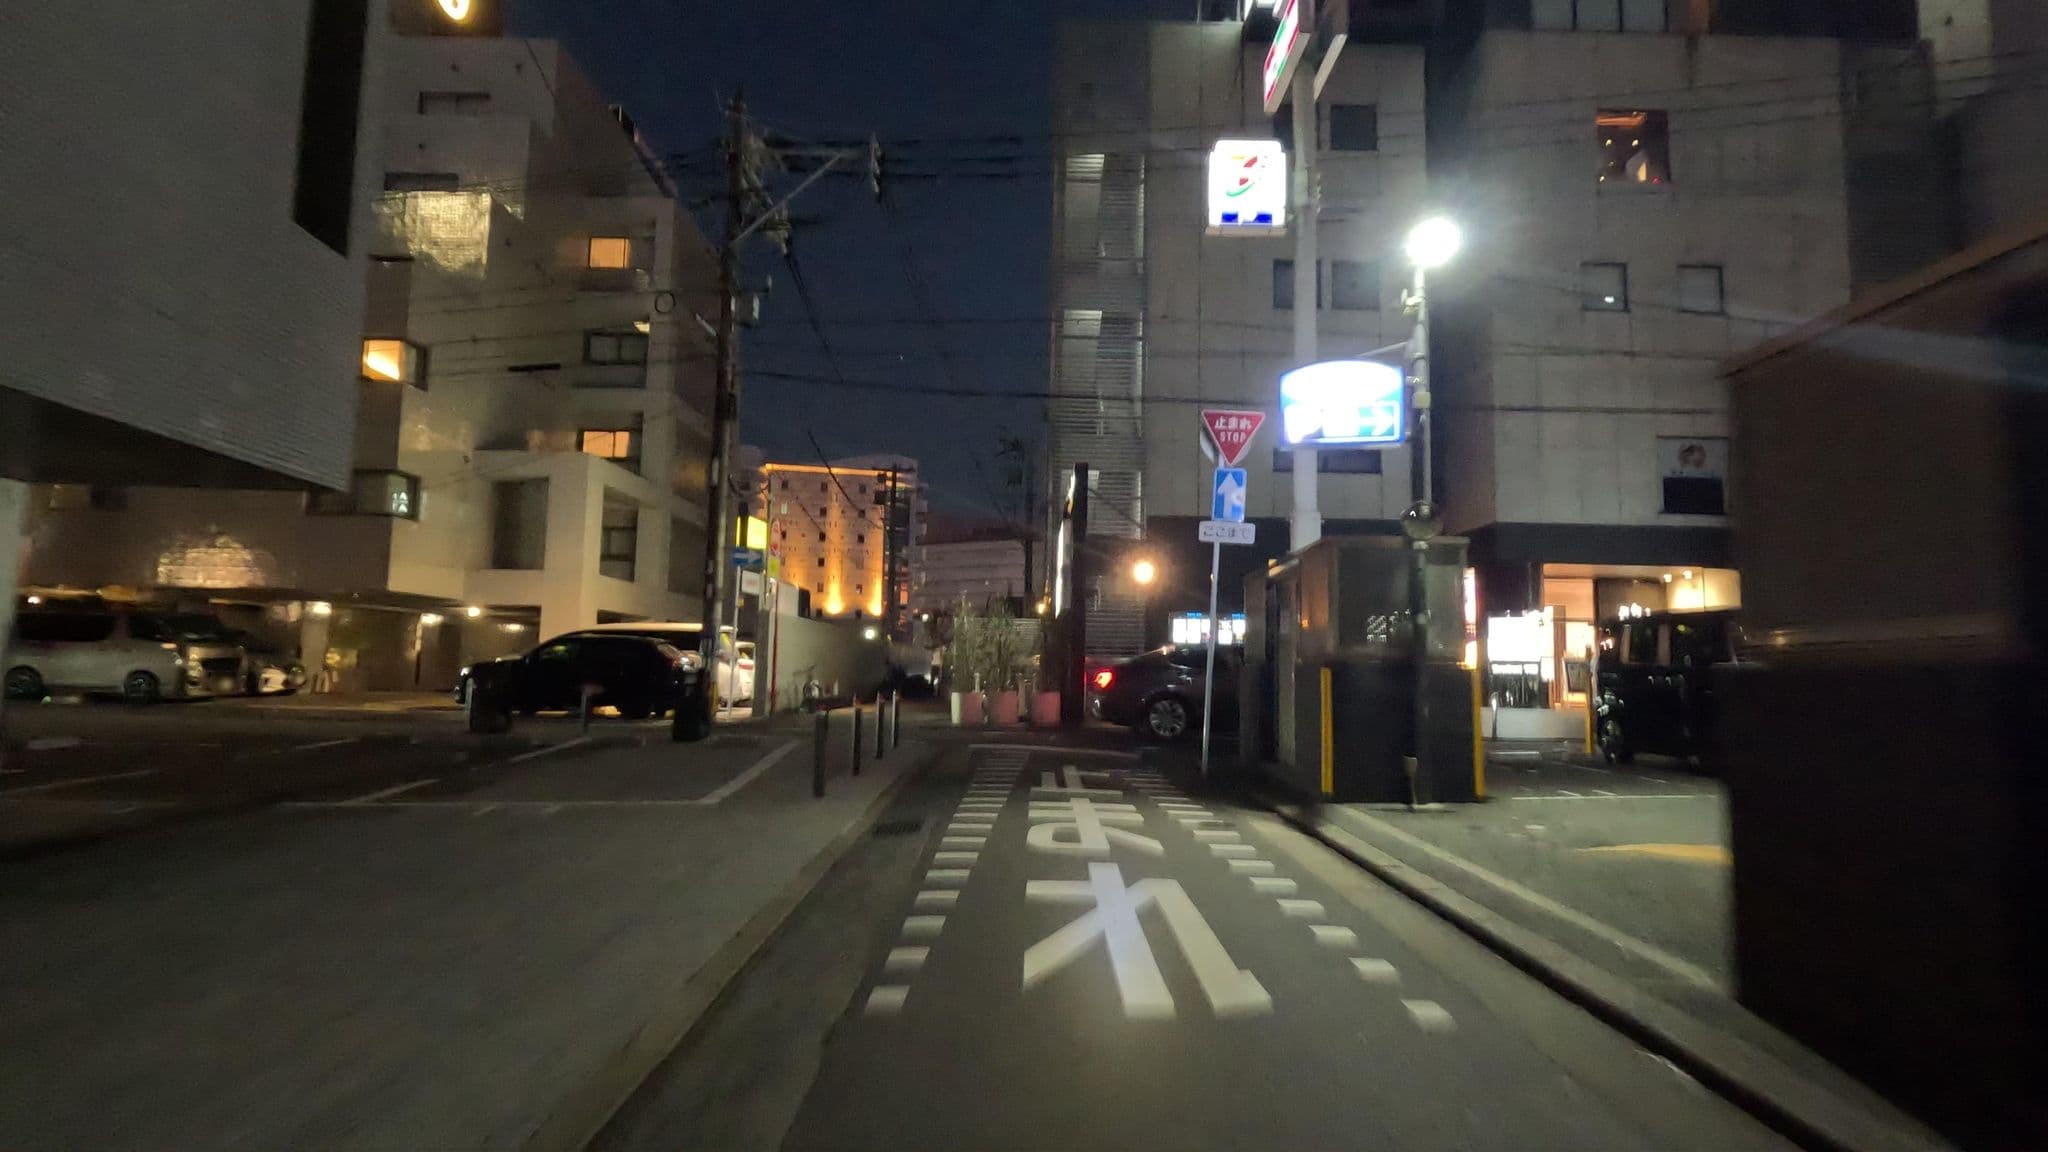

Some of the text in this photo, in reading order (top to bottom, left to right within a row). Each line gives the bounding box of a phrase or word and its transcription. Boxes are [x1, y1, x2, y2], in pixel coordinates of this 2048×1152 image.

[1214, 416, 1252, 430] 止まれ
[1219, 431, 1247, 443] STOP
[1202, 525, 1252, 540] ここまで
